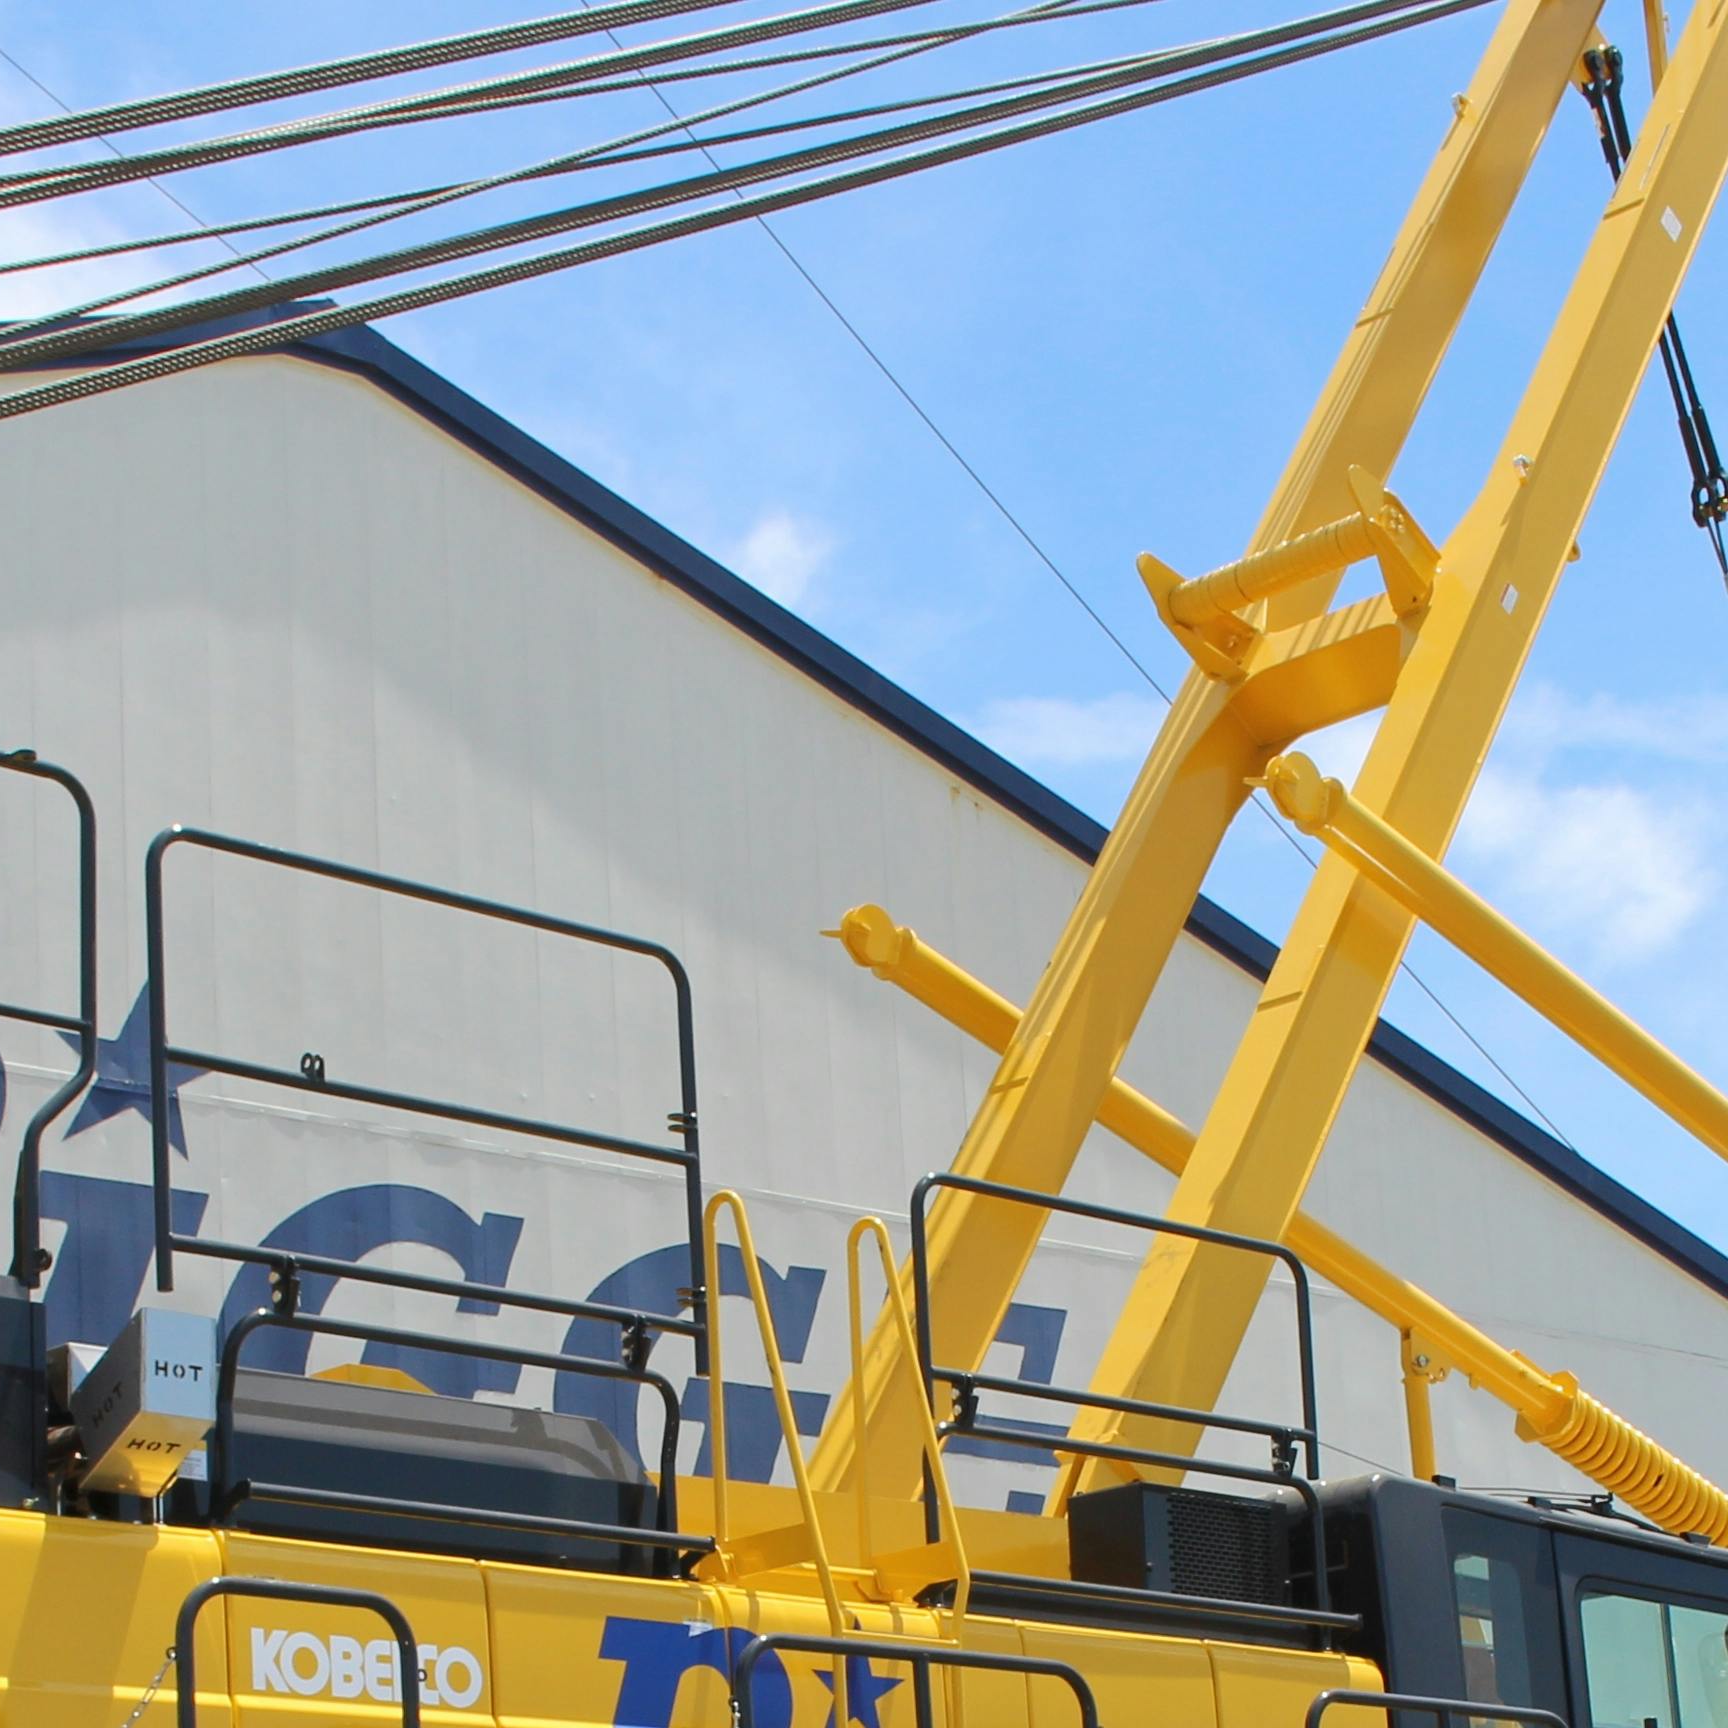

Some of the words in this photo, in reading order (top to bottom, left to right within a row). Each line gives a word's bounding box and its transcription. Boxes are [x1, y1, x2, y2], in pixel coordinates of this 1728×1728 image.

[154, 1360, 203, 1382] HOT
[93, 1381, 123, 1428] HOT
[127, 1438, 181, 1454] HOT
